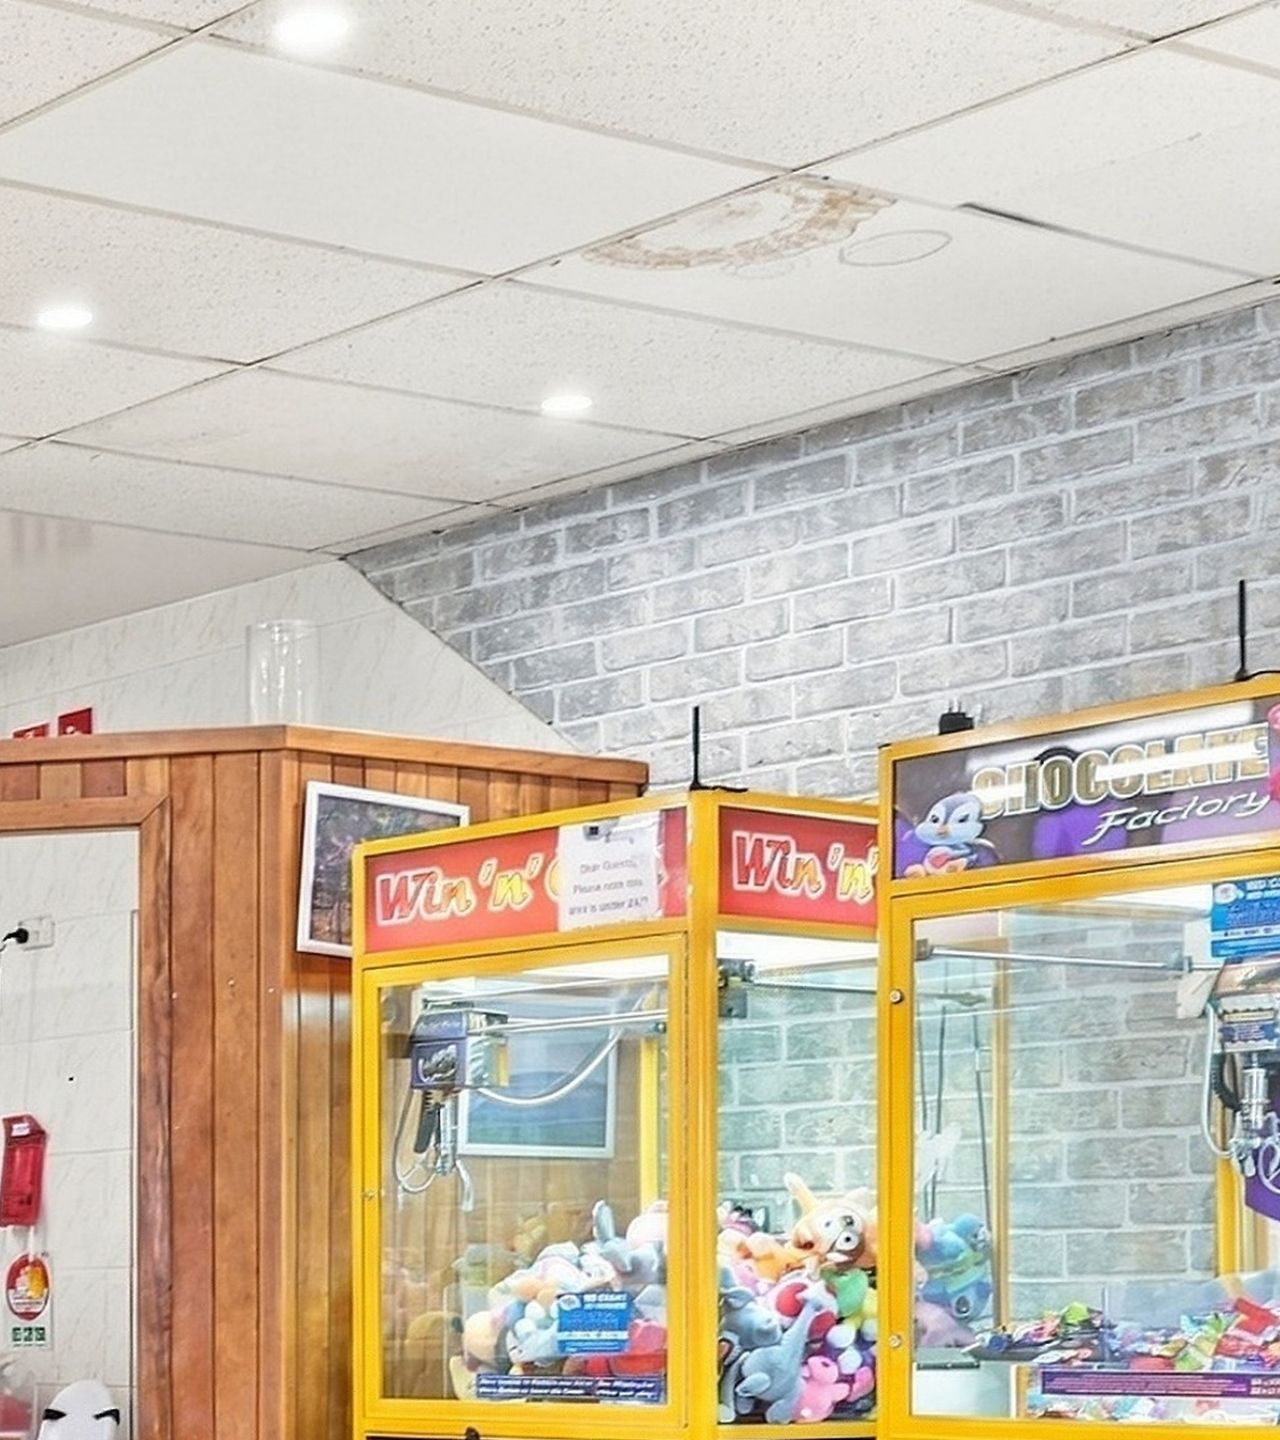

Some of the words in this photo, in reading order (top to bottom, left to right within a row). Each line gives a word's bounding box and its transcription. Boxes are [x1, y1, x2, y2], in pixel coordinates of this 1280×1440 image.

[971, 721, 1270, 820] CHOCOLATE
[1081, 791, 1271, 846] Factory
[376, 865, 477, 927] Win
[573, 883, 601, 895] Please
[732, 830, 827, 900] Win
